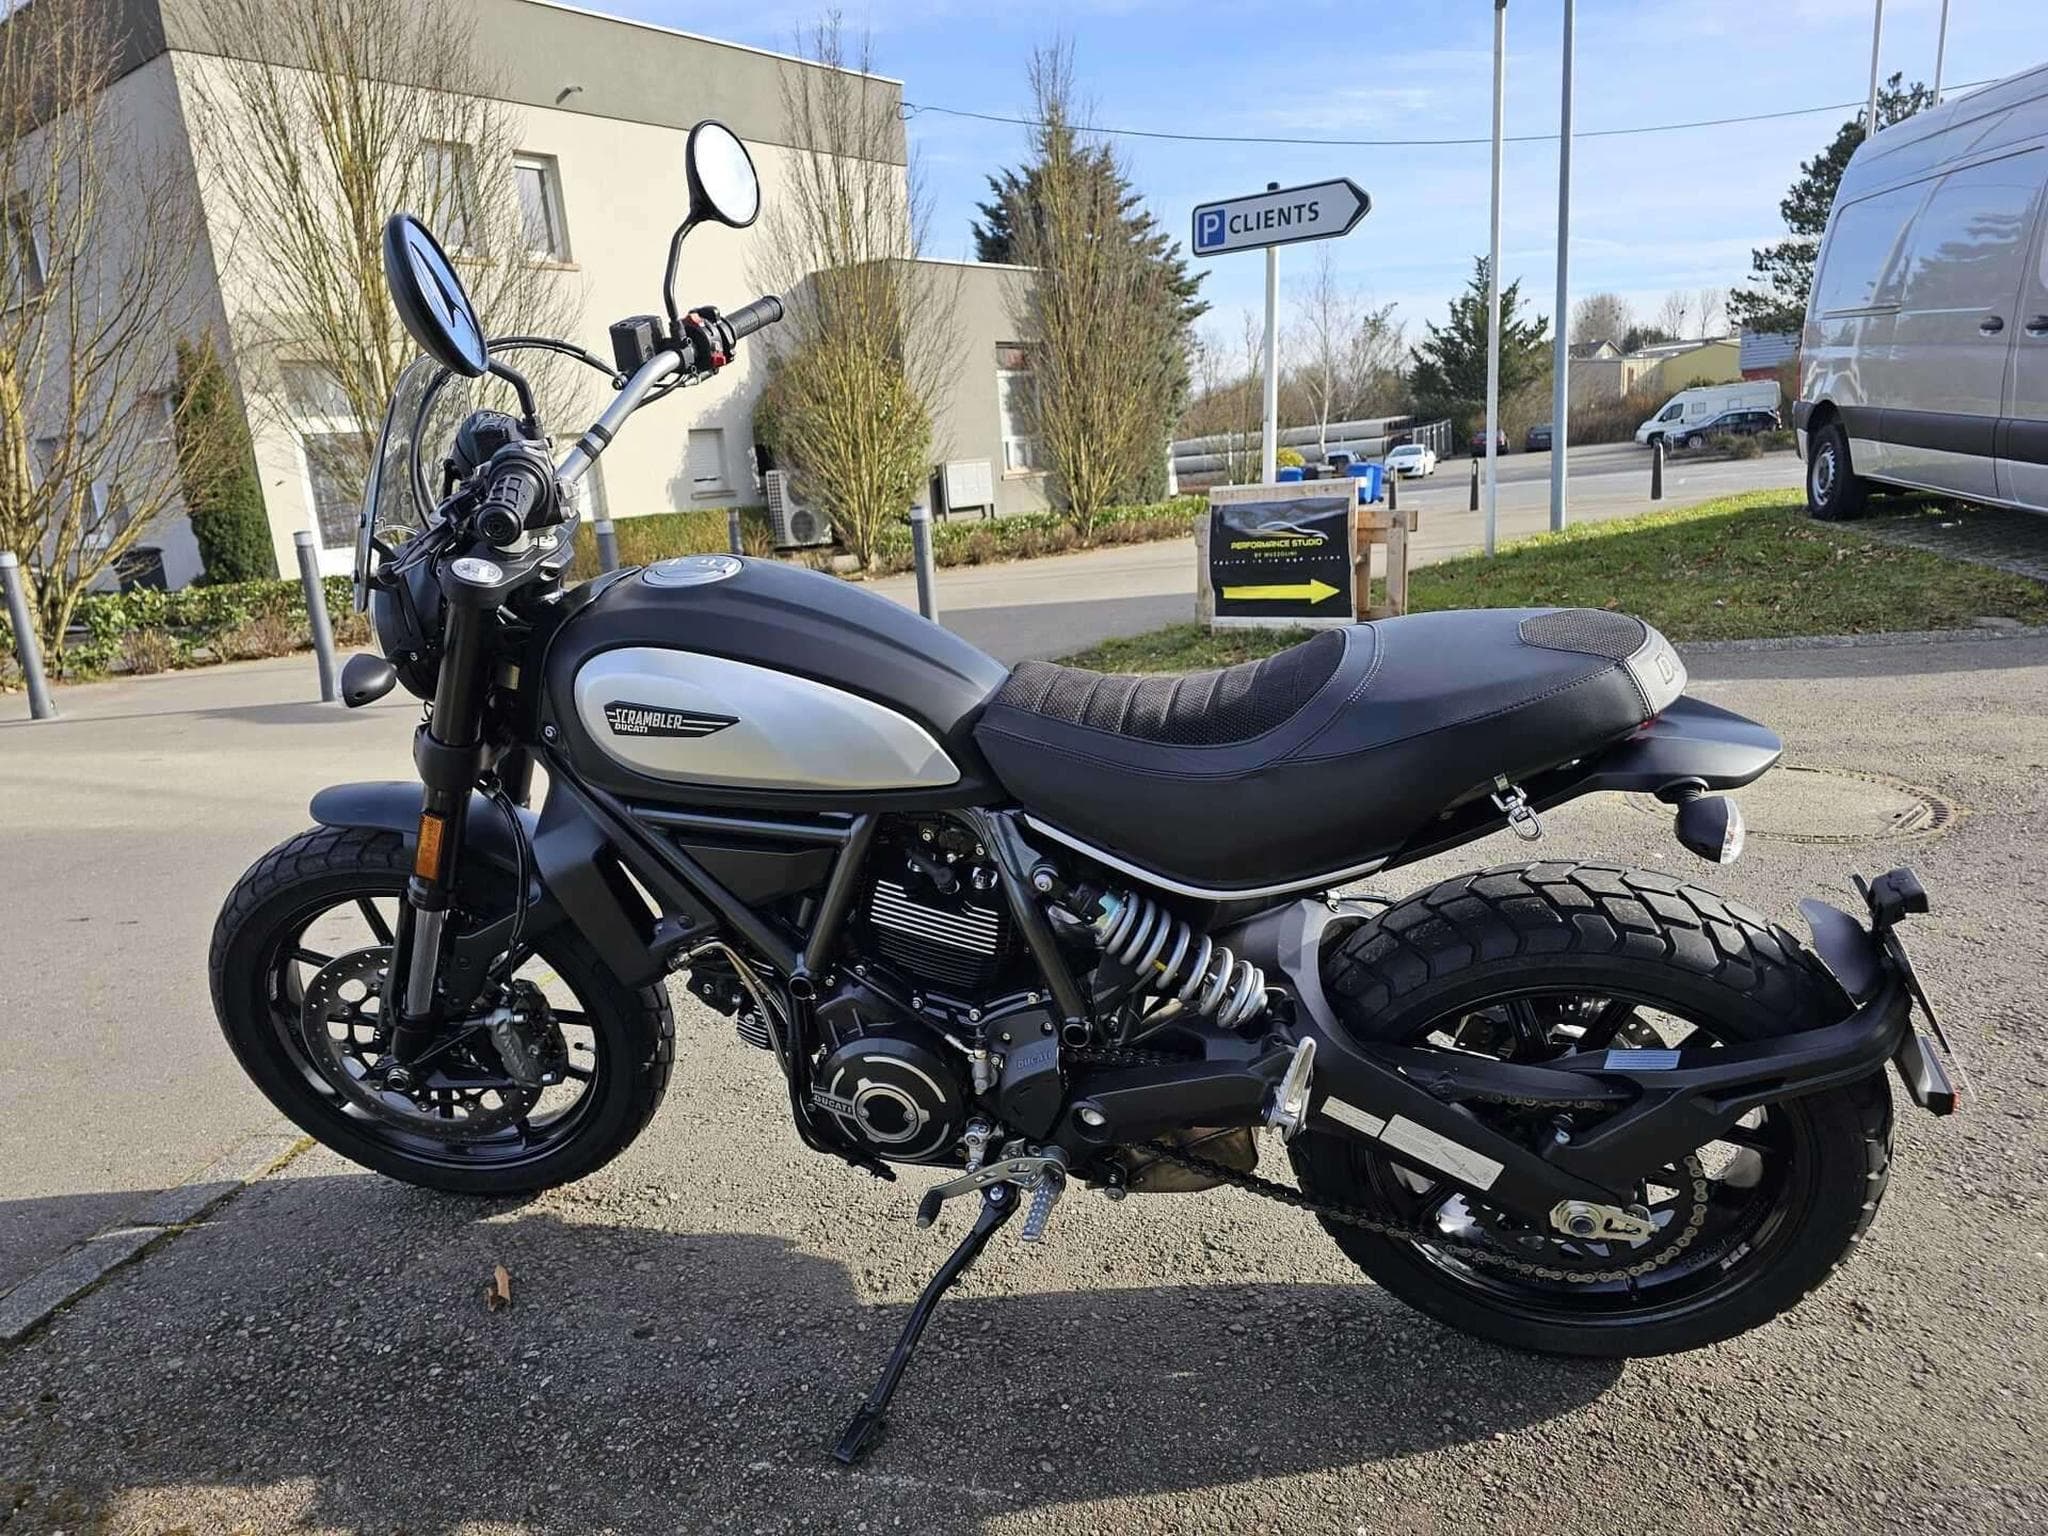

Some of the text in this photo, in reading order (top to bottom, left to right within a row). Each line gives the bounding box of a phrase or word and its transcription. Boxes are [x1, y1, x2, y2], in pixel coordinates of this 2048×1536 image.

[1203, 201, 1320, 245] P CLIENTS
[1231, 537, 1323, 550] PERFORMANCE STUDIO
[614, 708, 683, 730] SCRAMBLER
[614, 723, 648, 733] DUCATI
[813, 1094, 852, 1113] DUCATI
